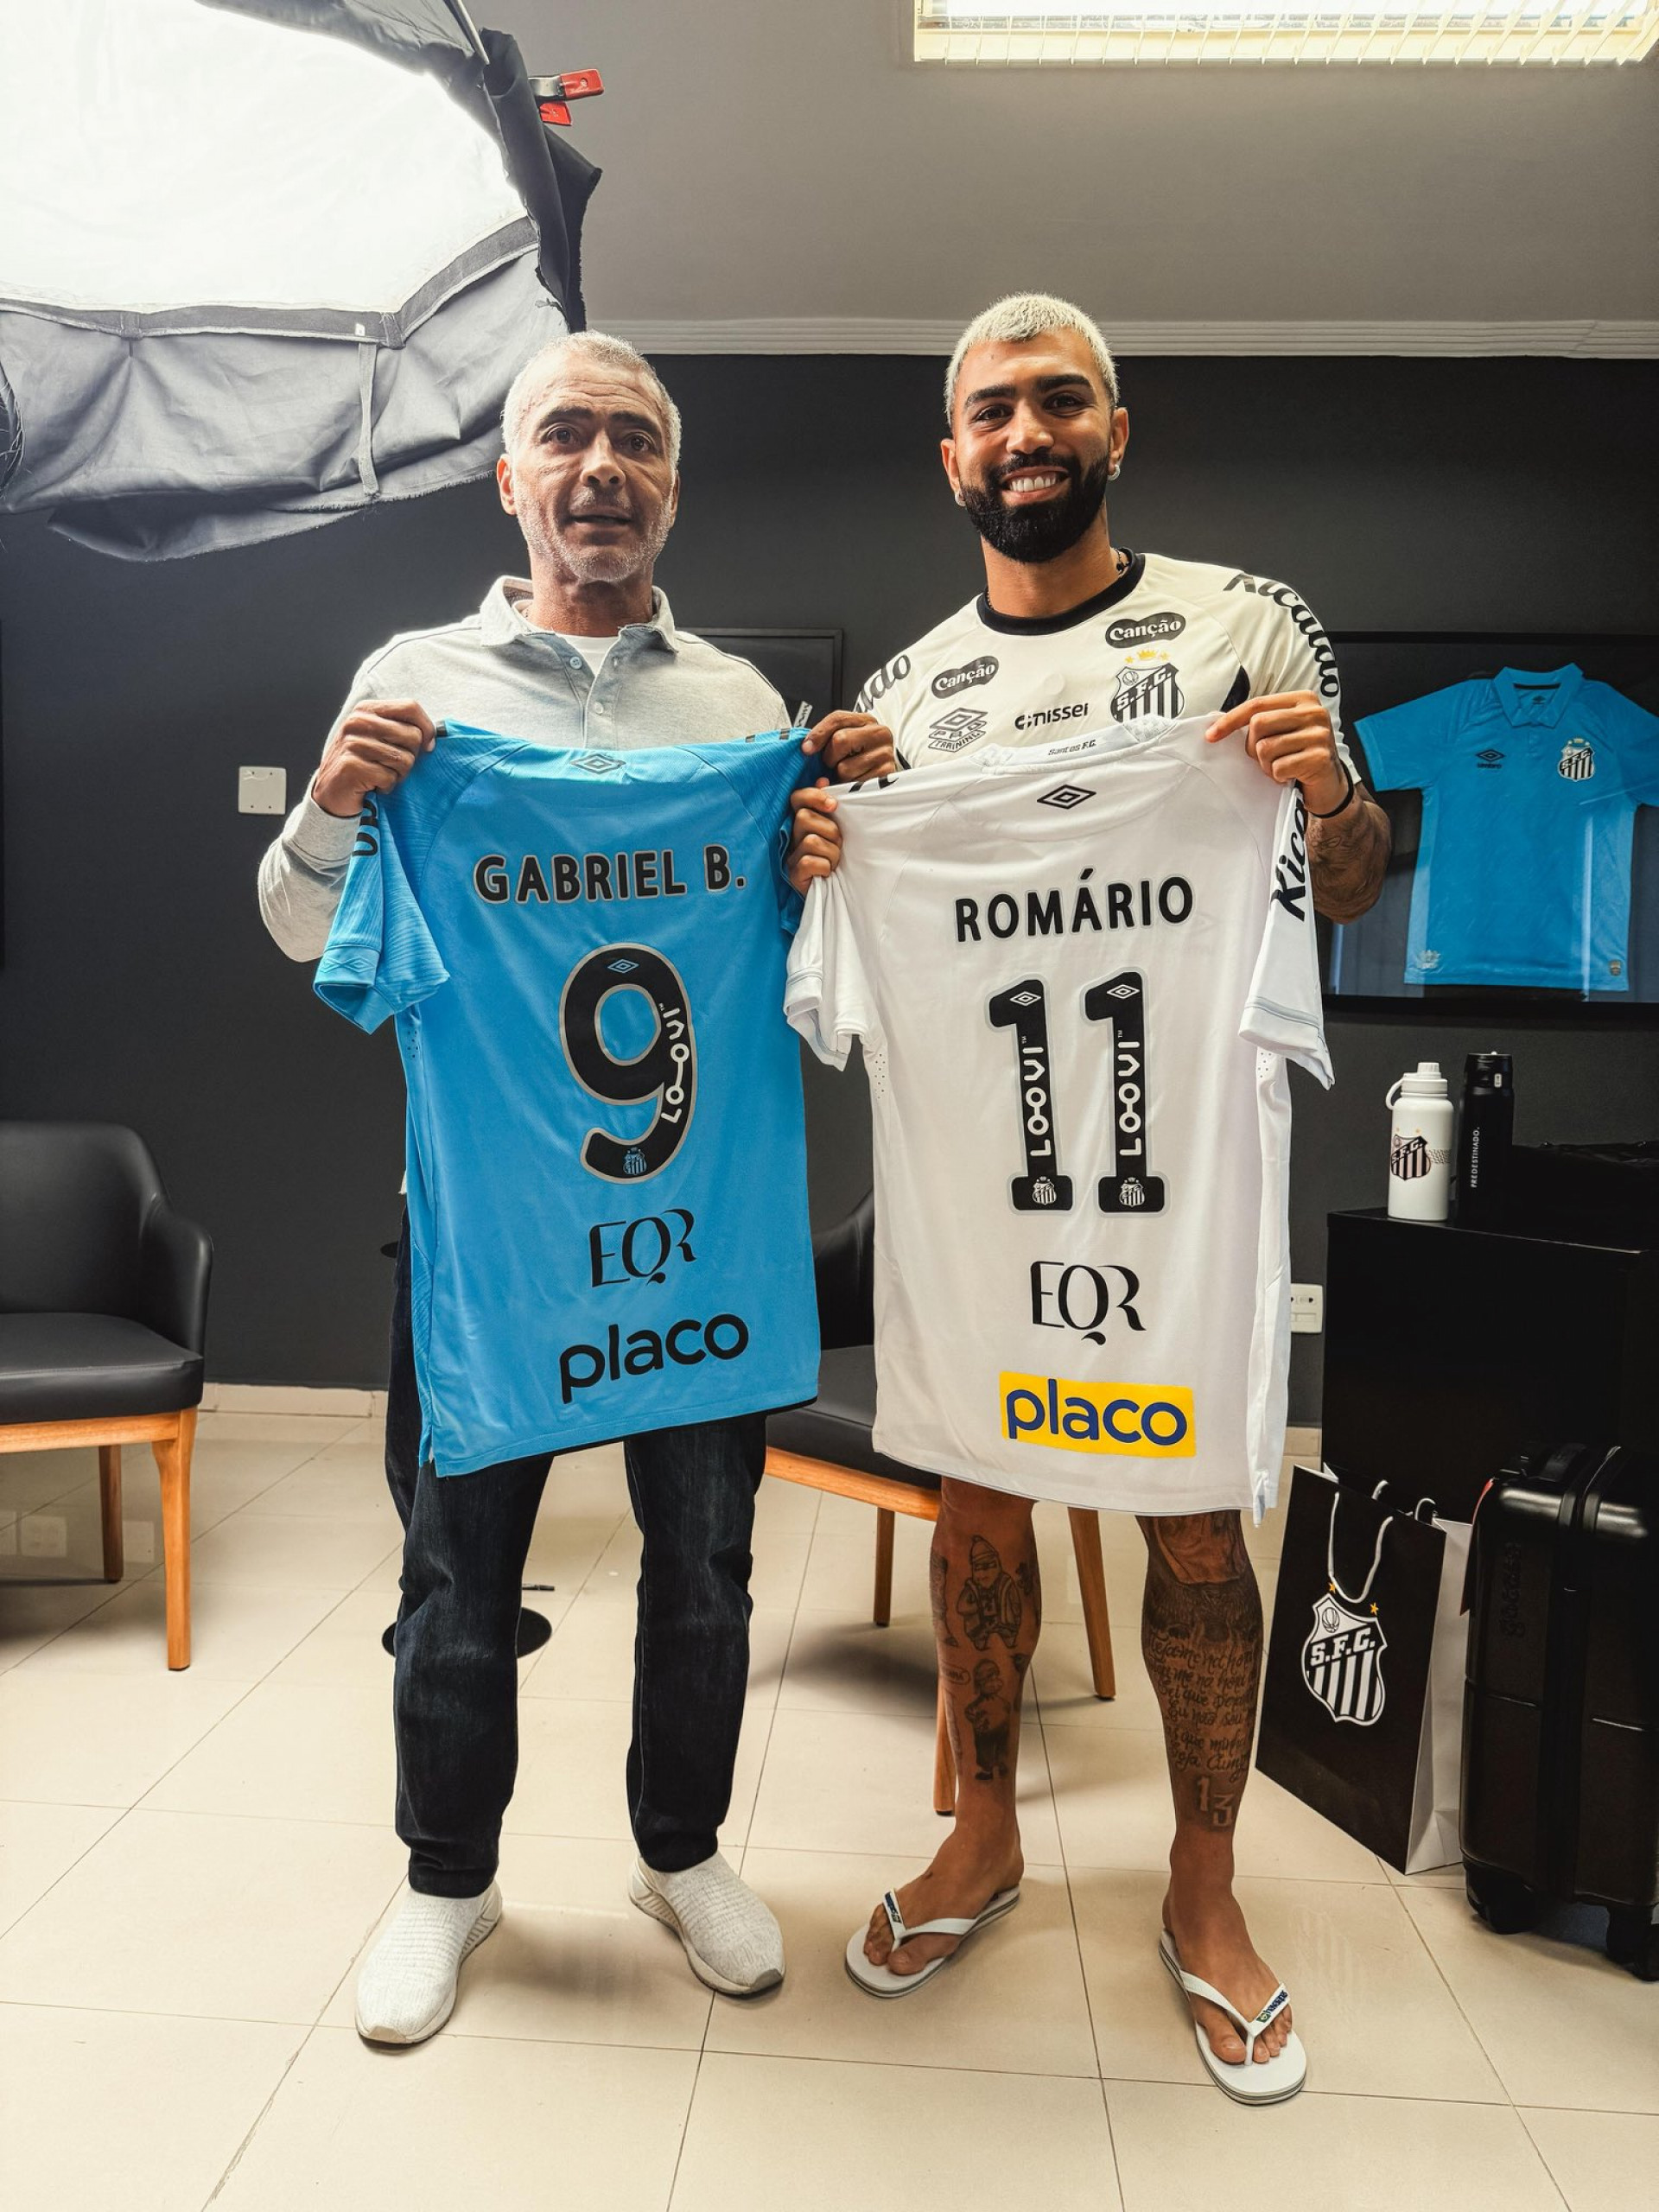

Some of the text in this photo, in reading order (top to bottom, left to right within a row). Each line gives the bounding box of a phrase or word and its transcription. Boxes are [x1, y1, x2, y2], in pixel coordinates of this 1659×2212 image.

[1109, 619, 1181, 641] Canção
[935, 664, 995, 691] Canção
[1048, 739, 1096, 756] Santos F.C.
[473, 844, 747, 904] GABRIEL B.
[954, 867, 1194, 943] ROMÁRIO
[559, 942, 697, 1184] 9
[987, 969, 1168, 1215] 11
[1022, 1046, 1052, 1156] LOOVI
[1117, 1041, 1141, 1156] LOOVI
[1470, 1126, 1481, 1189] PREDESTINADO.
[589, 1208, 696, 1287] EQR
[1030, 1261, 1147, 1345] EQR
[559, 1313, 749, 1404] placo
[1006, 1378, 1187, 1446] placo
[1310, 1627, 1376, 1667] S.F.C.
